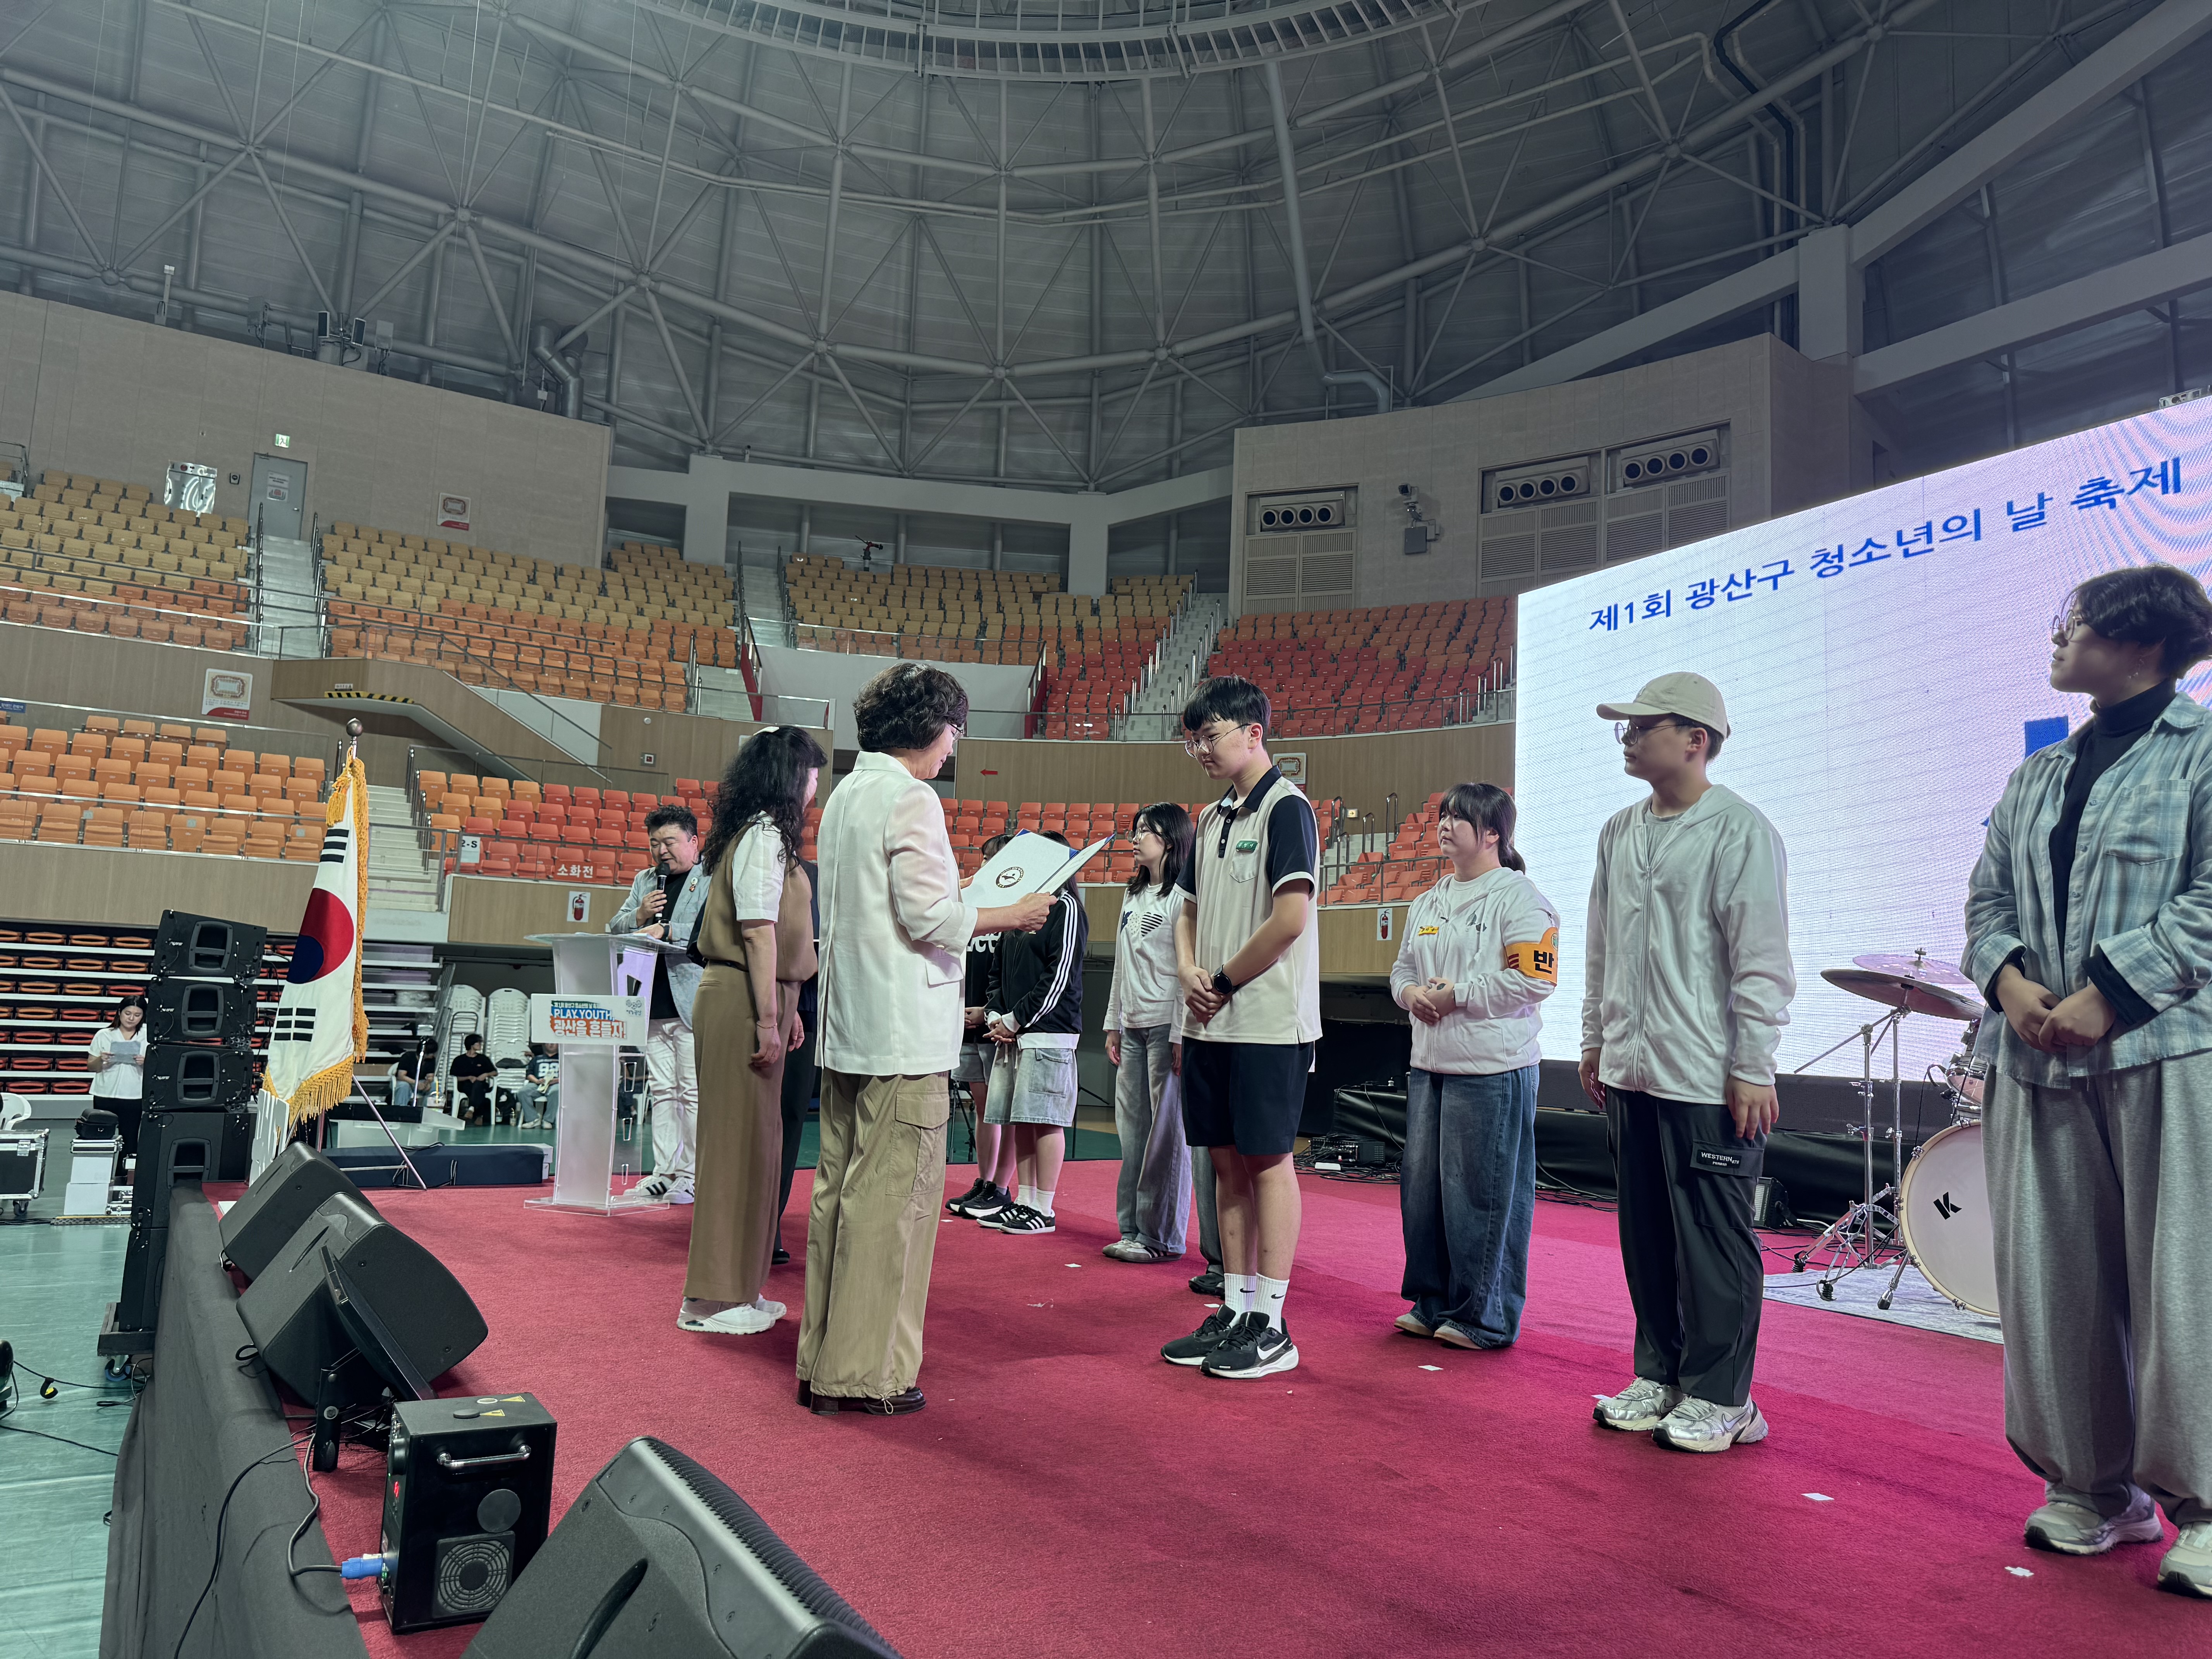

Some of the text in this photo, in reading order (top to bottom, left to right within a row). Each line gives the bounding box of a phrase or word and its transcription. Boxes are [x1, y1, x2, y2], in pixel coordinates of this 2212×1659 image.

[1589, 456, 2183, 631] 제1회 광산구 청소년의 날 축제
[557, 864, 593, 878] 소화전
[1534, 950, 1554, 974] 반
[554, 1008, 577, 1018] PLAY
[554, 1019, 627, 1039] 광산을 흔들자!
[1701, 1152, 1732, 1162] WESTERN
